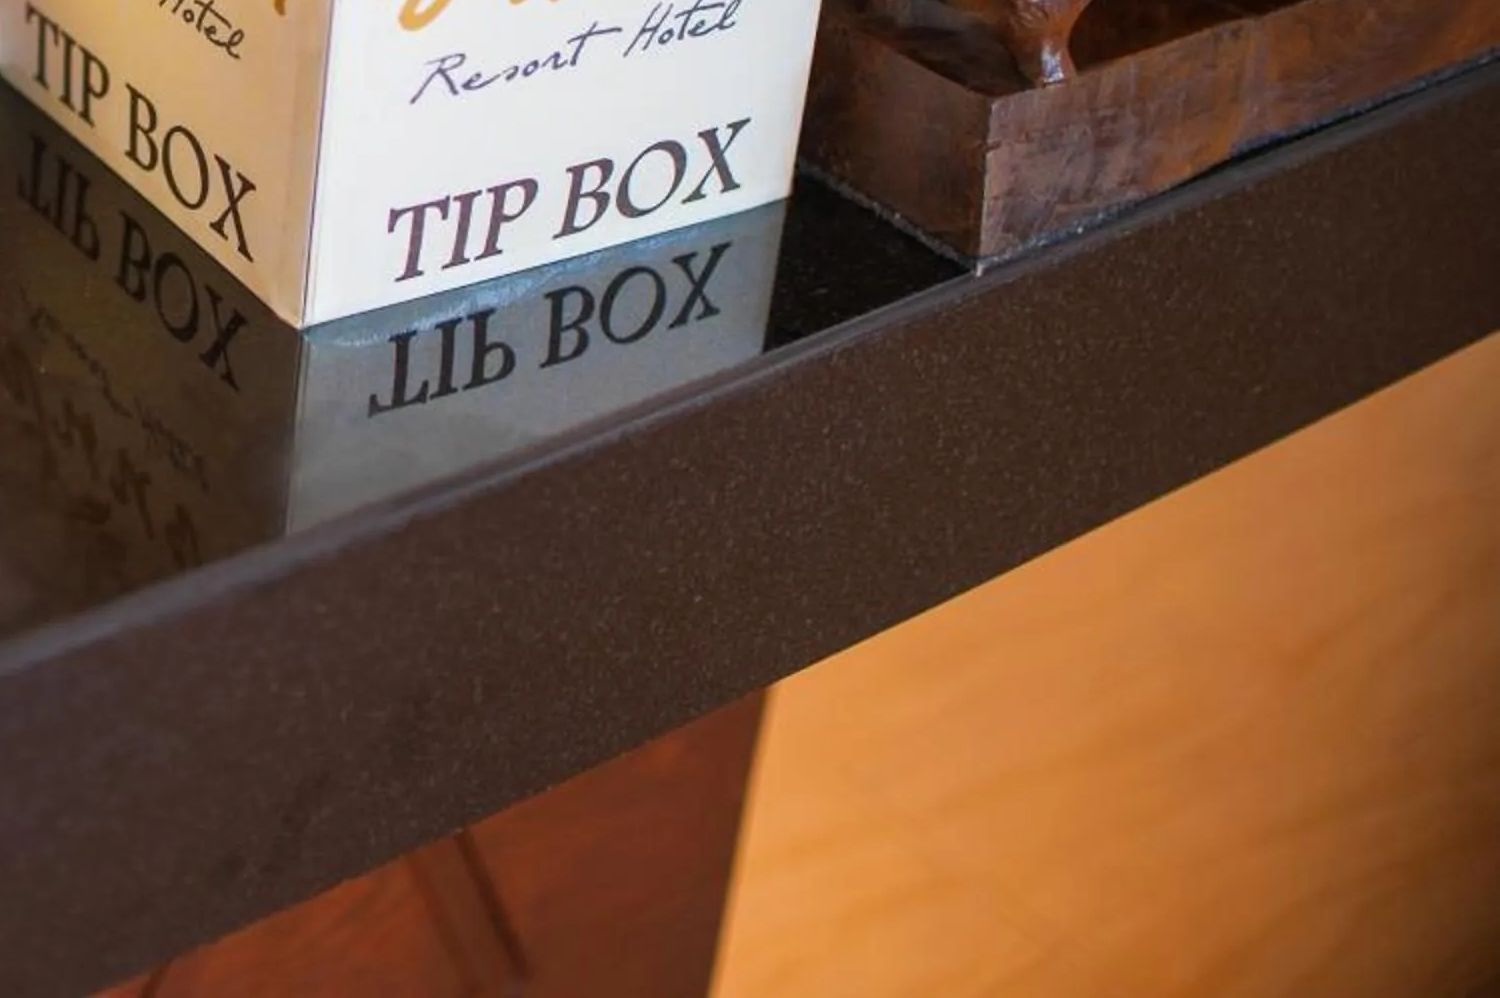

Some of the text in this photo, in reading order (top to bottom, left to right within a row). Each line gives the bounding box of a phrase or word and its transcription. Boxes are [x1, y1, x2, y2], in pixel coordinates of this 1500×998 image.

[24, 0, 257, 264] TIP BOX
[409, 20, 623, 105] Resort
[387, 116, 752, 283] TIP BOX
